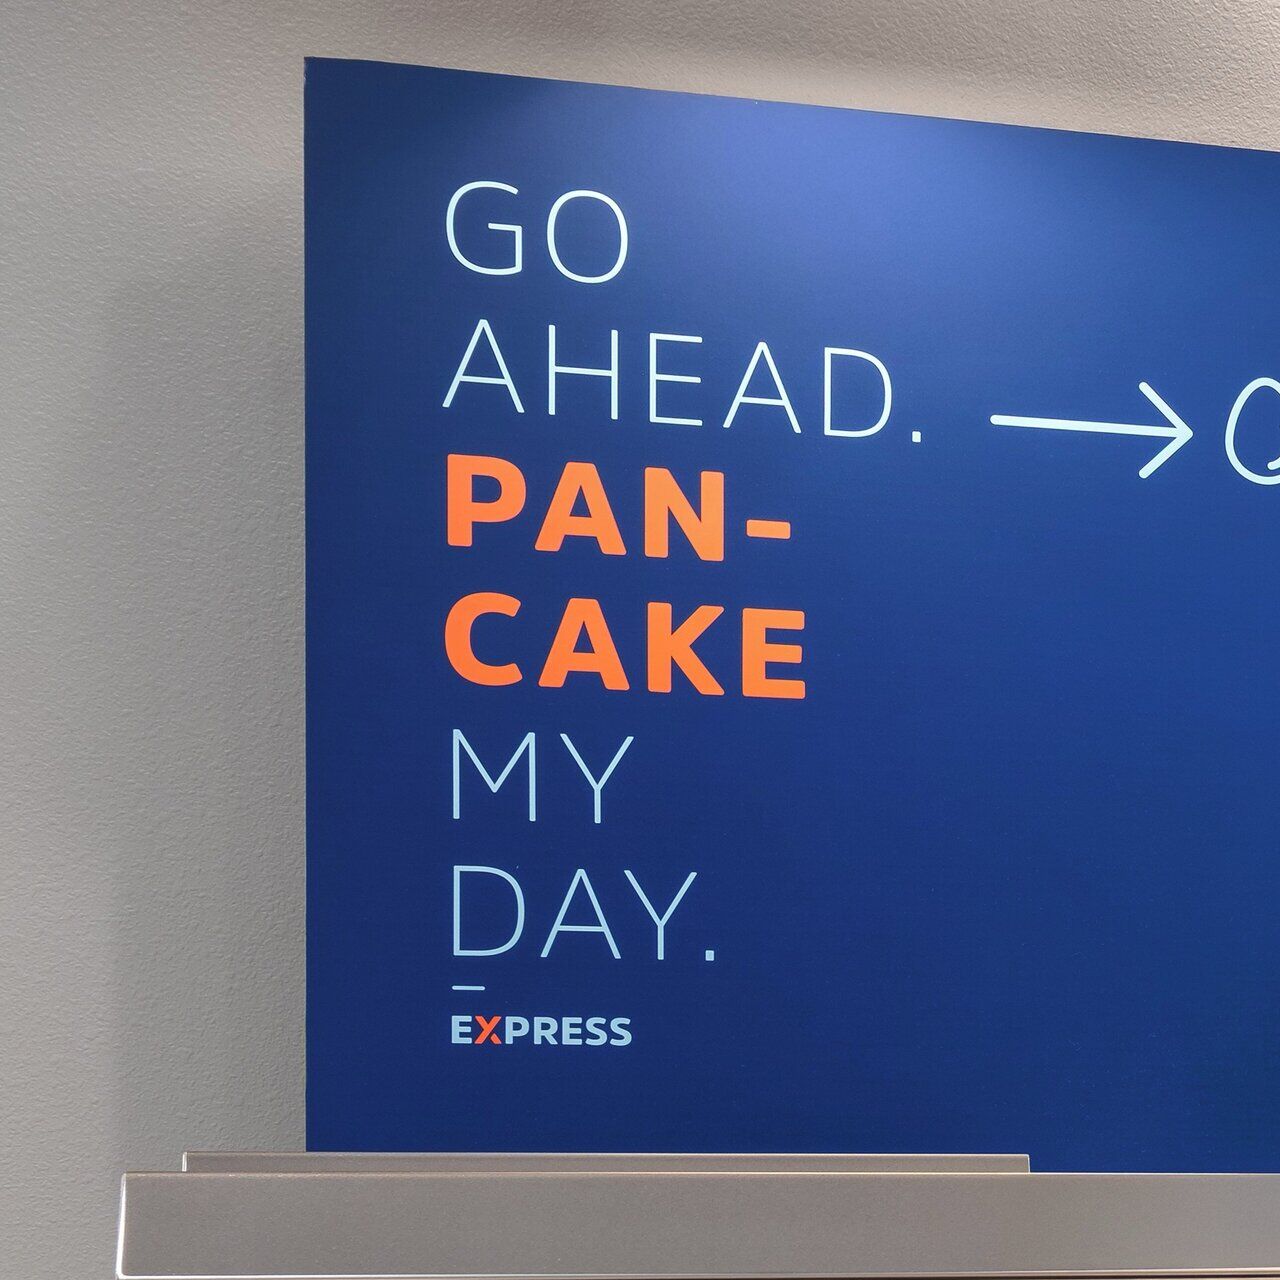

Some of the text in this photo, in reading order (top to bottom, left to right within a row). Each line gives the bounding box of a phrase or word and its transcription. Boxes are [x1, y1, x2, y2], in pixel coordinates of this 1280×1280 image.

[446, 180, 629, 284] GO
[442, 318, 922, 443] AHEAD.
[447, 453, 792, 562] PAN-
[445, 591, 806, 700] CAKE
[452, 728, 635, 824] MY
[453, 865, 715, 962] DAY.
[451, 1014, 633, 1047] EXPRESS
